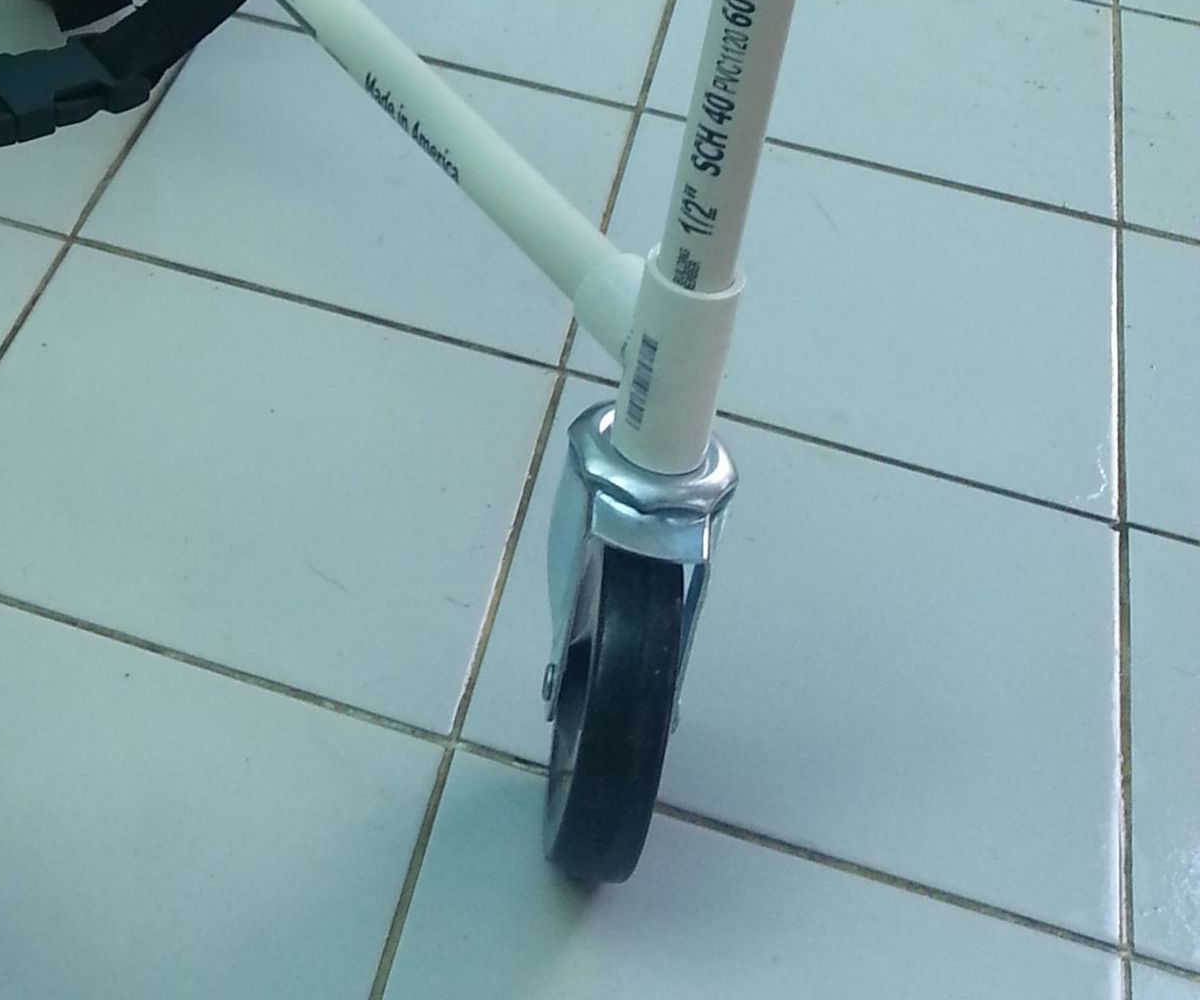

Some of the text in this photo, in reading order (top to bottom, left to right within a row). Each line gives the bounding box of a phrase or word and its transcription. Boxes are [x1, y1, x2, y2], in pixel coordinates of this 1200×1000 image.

[711, 28, 749, 95] PVC1120
[701, 91, 736, 126] 40
[689, 124, 729, 177] SCH
[677, 182, 718, 237] 1/2"
